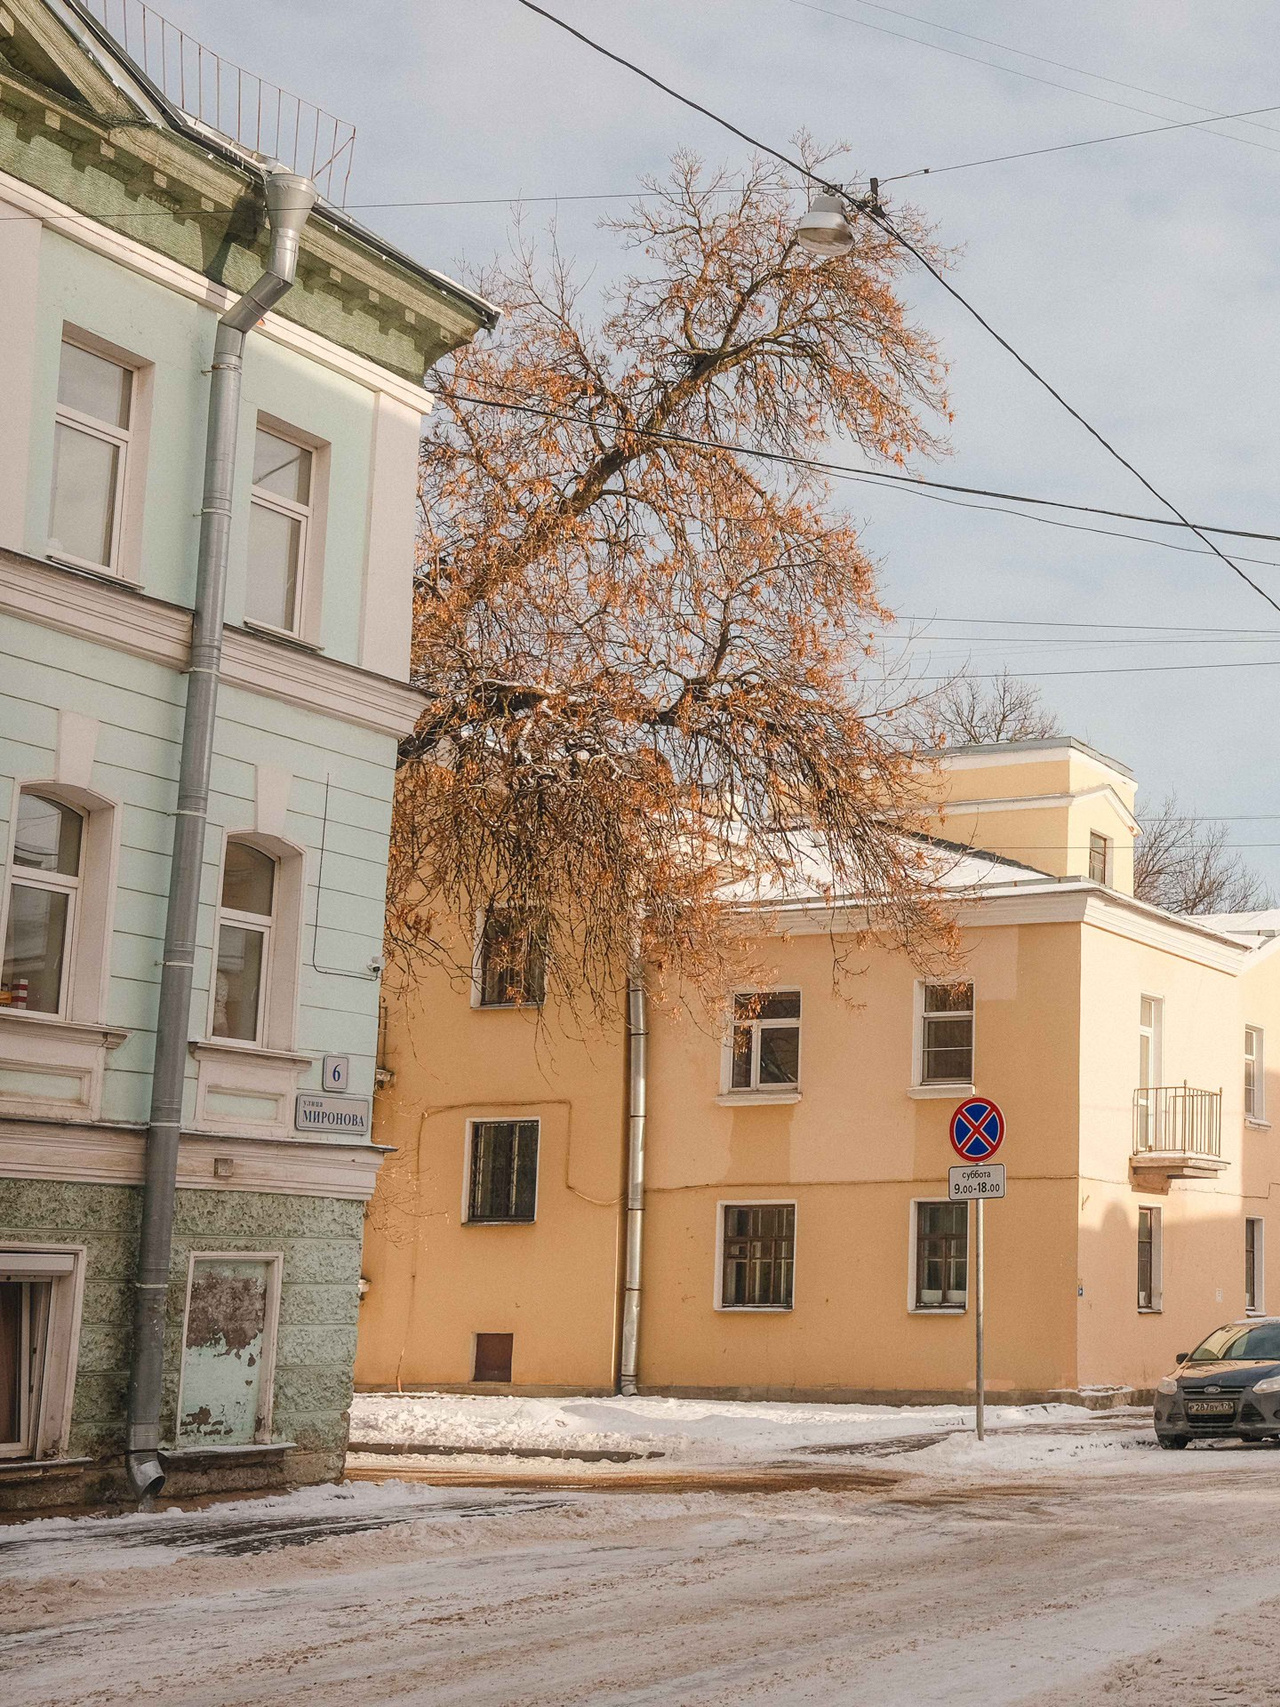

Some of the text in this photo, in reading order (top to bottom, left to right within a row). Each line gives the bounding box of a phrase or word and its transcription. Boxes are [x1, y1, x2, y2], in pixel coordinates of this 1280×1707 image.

[332, 1063, 341, 1082] 6
[303, 1100, 323, 1108] улица
[302, 1110, 364, 1127] МИРОНОВА
[961, 1170, 991, 1181] суббота
[954, 1182, 1000, 1194] 9.00-18.00
